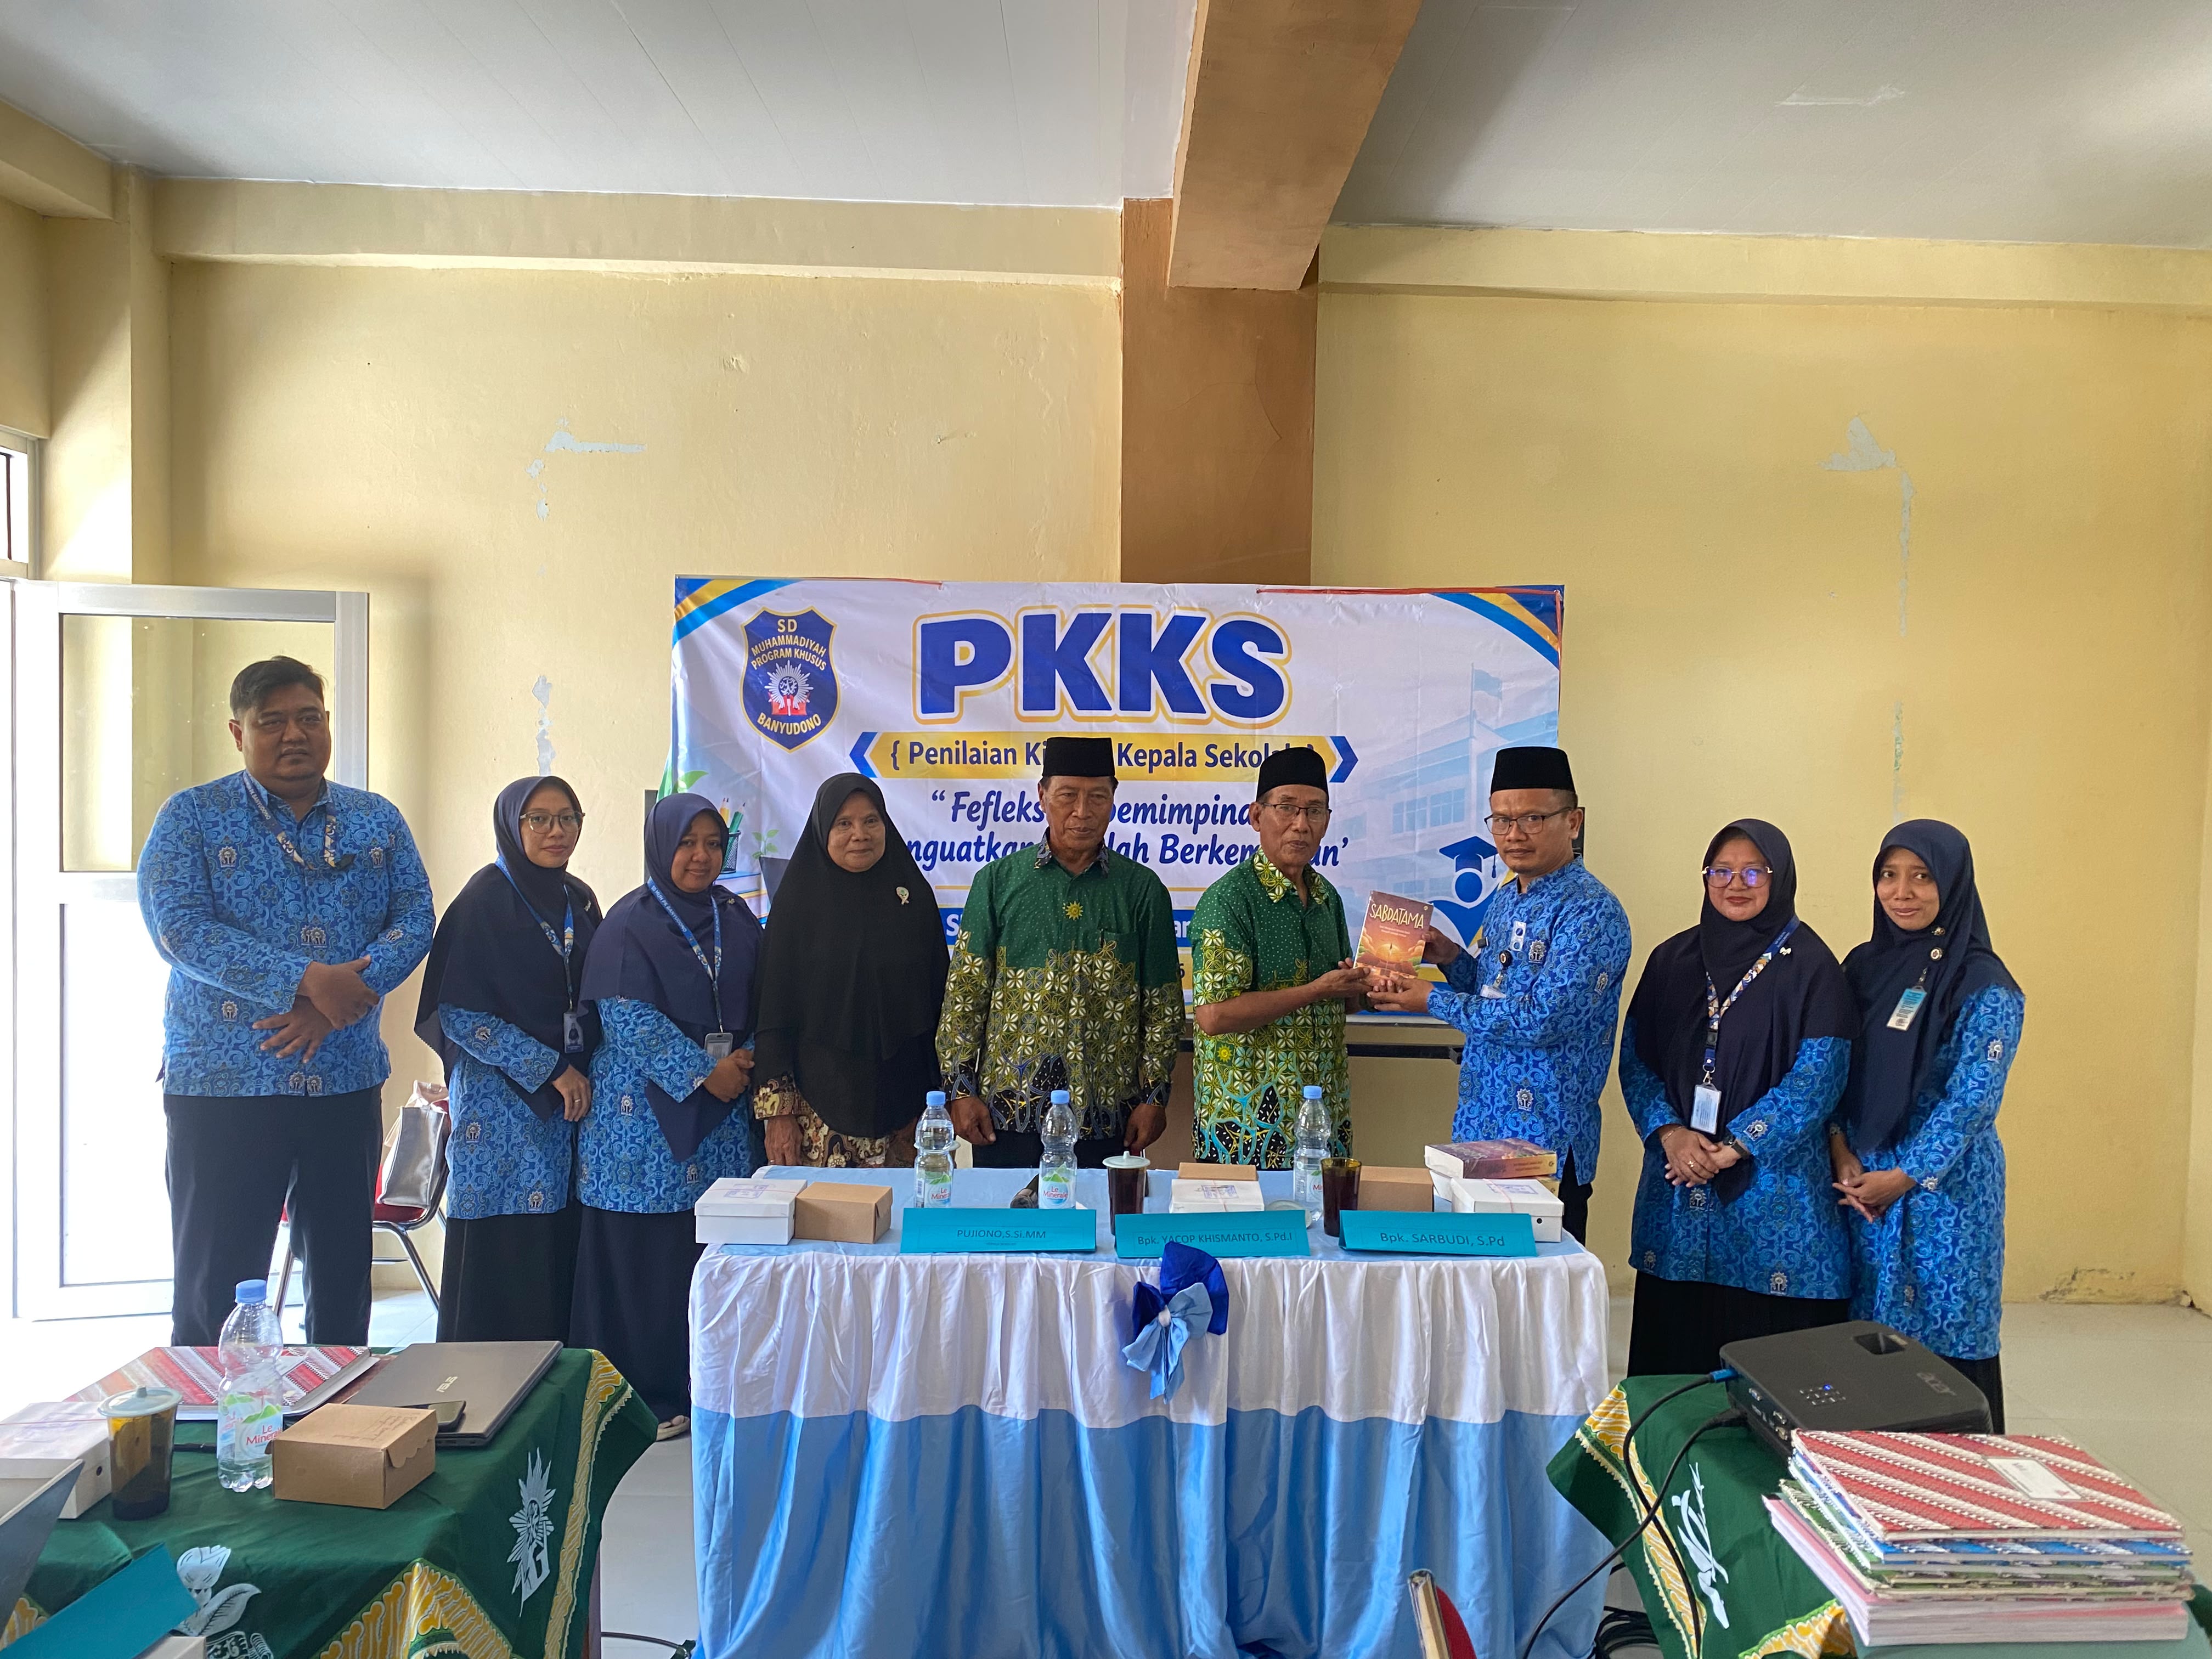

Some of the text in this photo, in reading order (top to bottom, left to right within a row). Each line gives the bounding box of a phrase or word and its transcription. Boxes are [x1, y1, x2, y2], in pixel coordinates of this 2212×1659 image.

[777, 618, 798, 633] SD
[751, 635, 827, 657] MUHAMMADIYAH
[751, 647, 827, 671] PROGRAM KHUSUS
[919, 612, 1285, 719] PKKS
[757, 712, 821, 735] BANYUDONO
[909, 740, 1017, 765] Penilaian
[1117, 742, 1198, 774] Kepala
[1205, 742, 1290, 768] Sekol
[252, 794, 271, 820] BANYUDONO
[951, 790, 1046, 832] Fefleks
[654, 889, 664, 901] MUH
[666, 906, 687, 932] BANYUDONO
[1369, 903, 1424, 929] SABDATAMA
[1043, 1190, 1068, 1198] Minerale
[957, 1229, 1046, 1239] PUJIONO,S.Si.MM
[1138, 1232, 1292, 1246] Bpk. YACOP KHISMANTO, S.Pd.I
[1380, 1232, 1505, 1246] Bpk. SARBUDI, S.Pd
[1916, 1372, 1957, 1396] acer
[262, 1424, 273, 1435] Le
